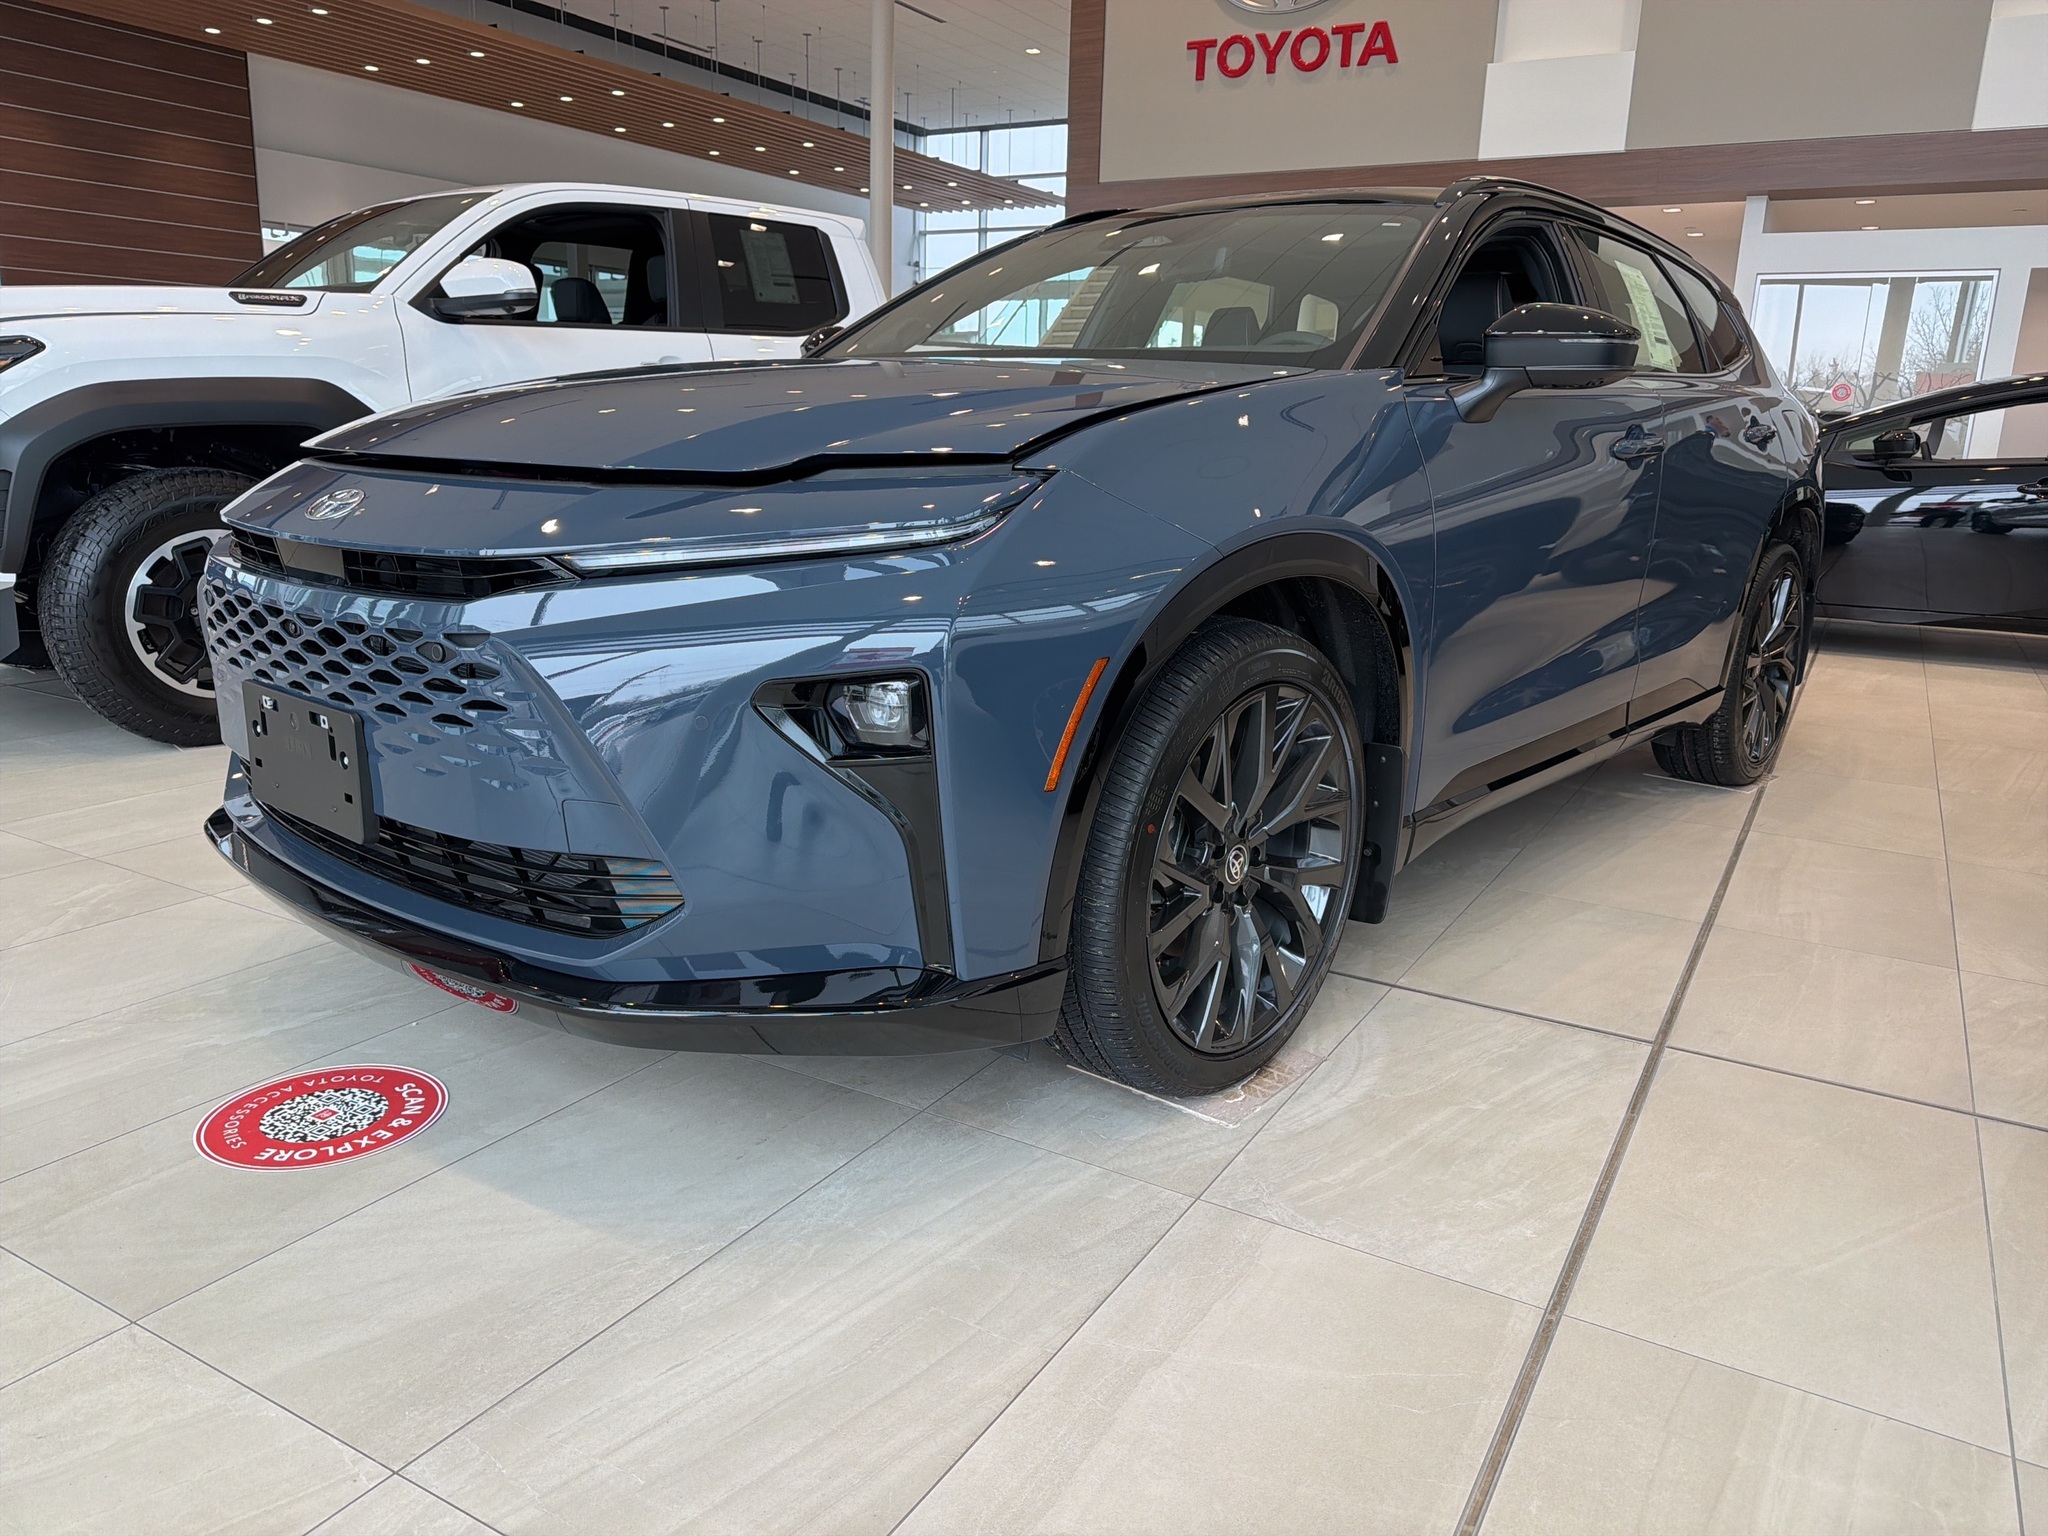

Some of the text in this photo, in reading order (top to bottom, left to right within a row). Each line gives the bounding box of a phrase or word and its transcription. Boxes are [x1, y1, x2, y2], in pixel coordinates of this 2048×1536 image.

[1187, 20, 1399, 81] TOYOTA
[223, 1074, 384, 1149] TOYOTA ACCESSORIES
[253, 1083, 425, 1161] SCAN & EXPLORE
